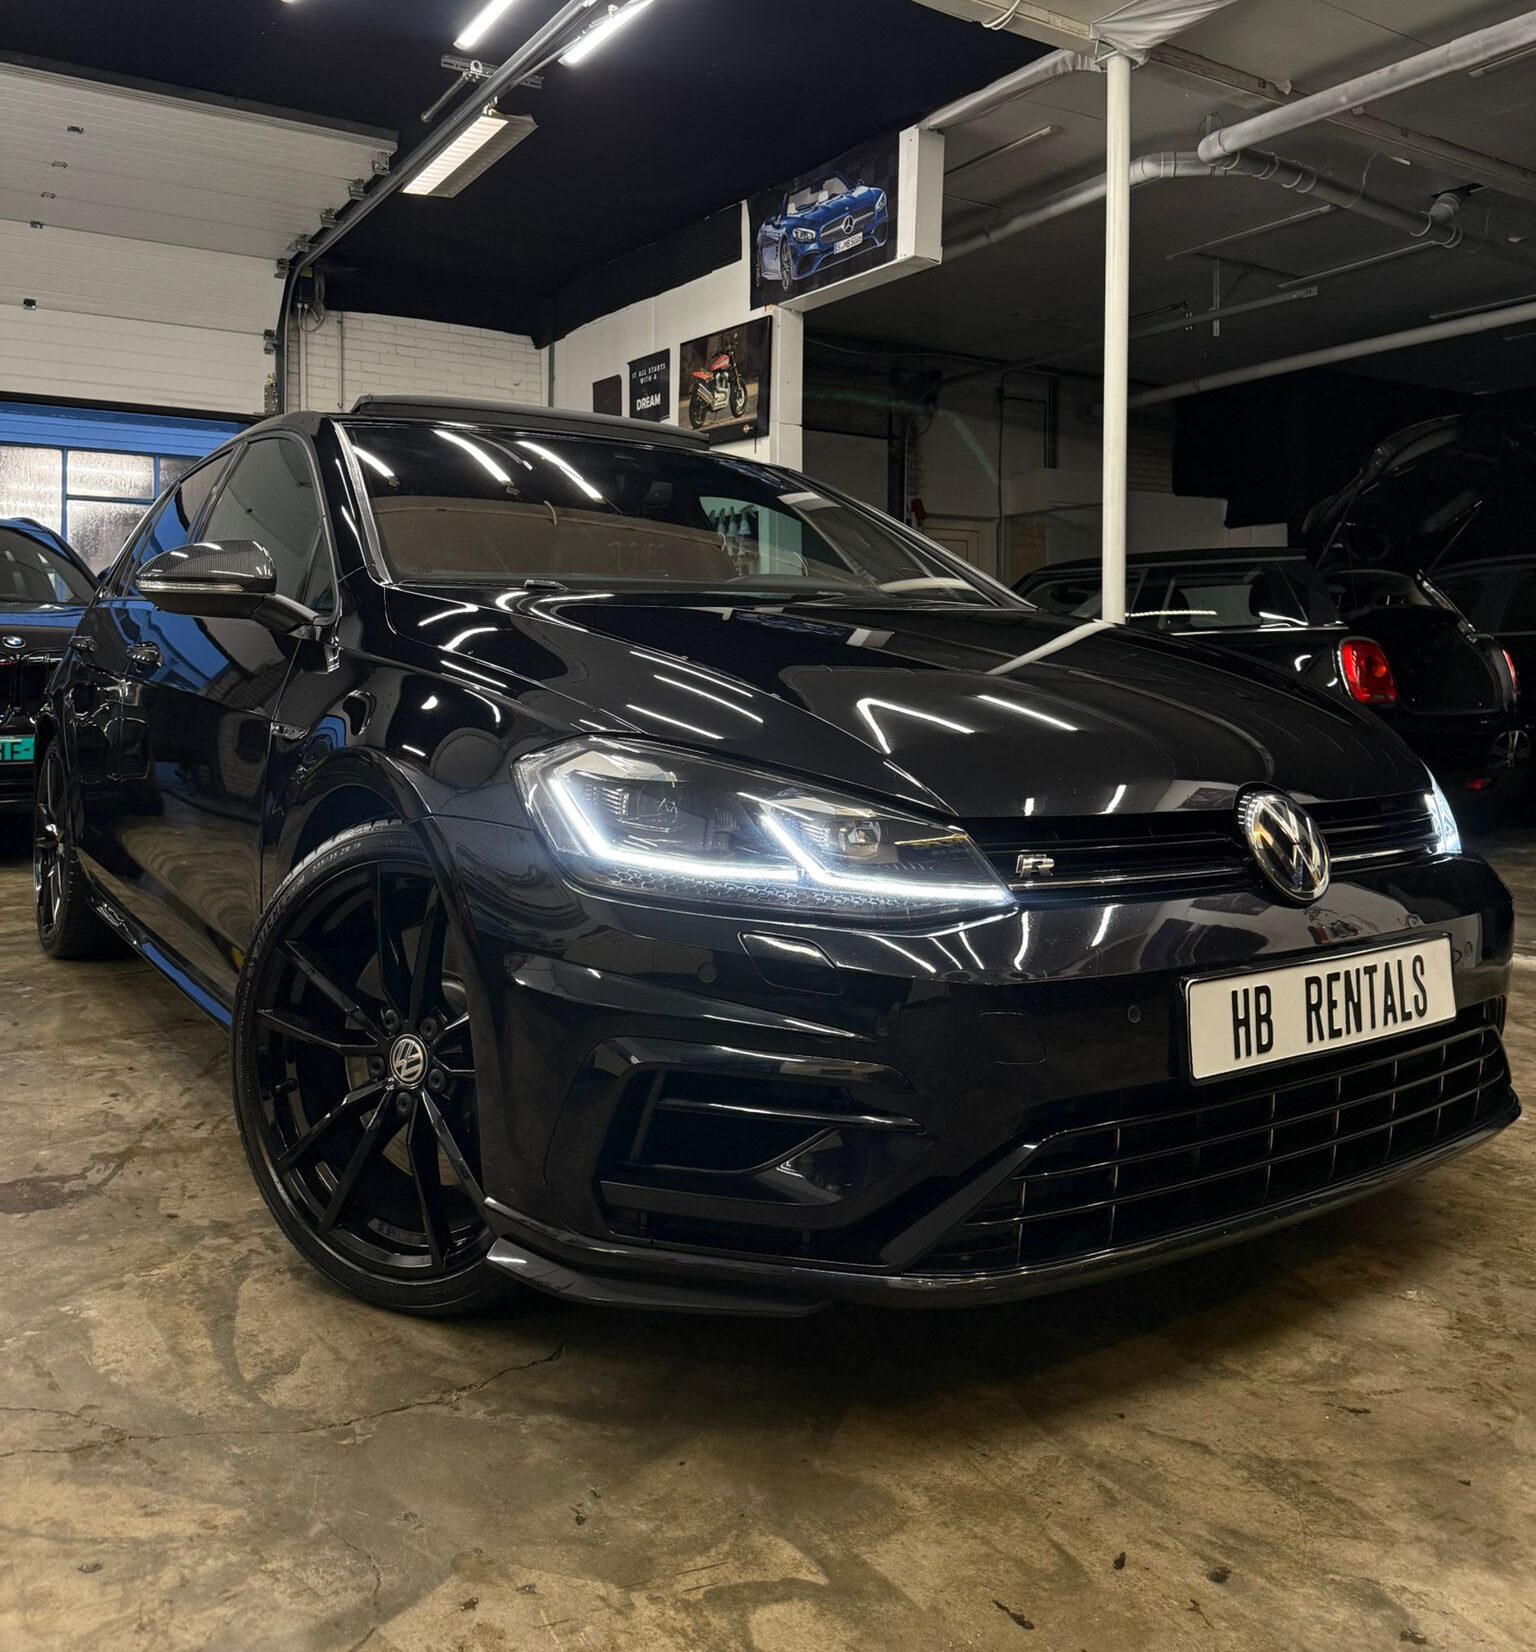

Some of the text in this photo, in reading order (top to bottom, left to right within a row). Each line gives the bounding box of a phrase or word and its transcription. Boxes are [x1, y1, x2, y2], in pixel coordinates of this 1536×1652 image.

[638, 368, 647, 377] ALL
[648, 363, 666, 374] STARTS
[640, 375, 652, 384] WITH
[636, 393, 661, 411] DREAM
[1017, 853, 1055, 879] R
[1231, 954, 1428, 1060] HB RENTALS
